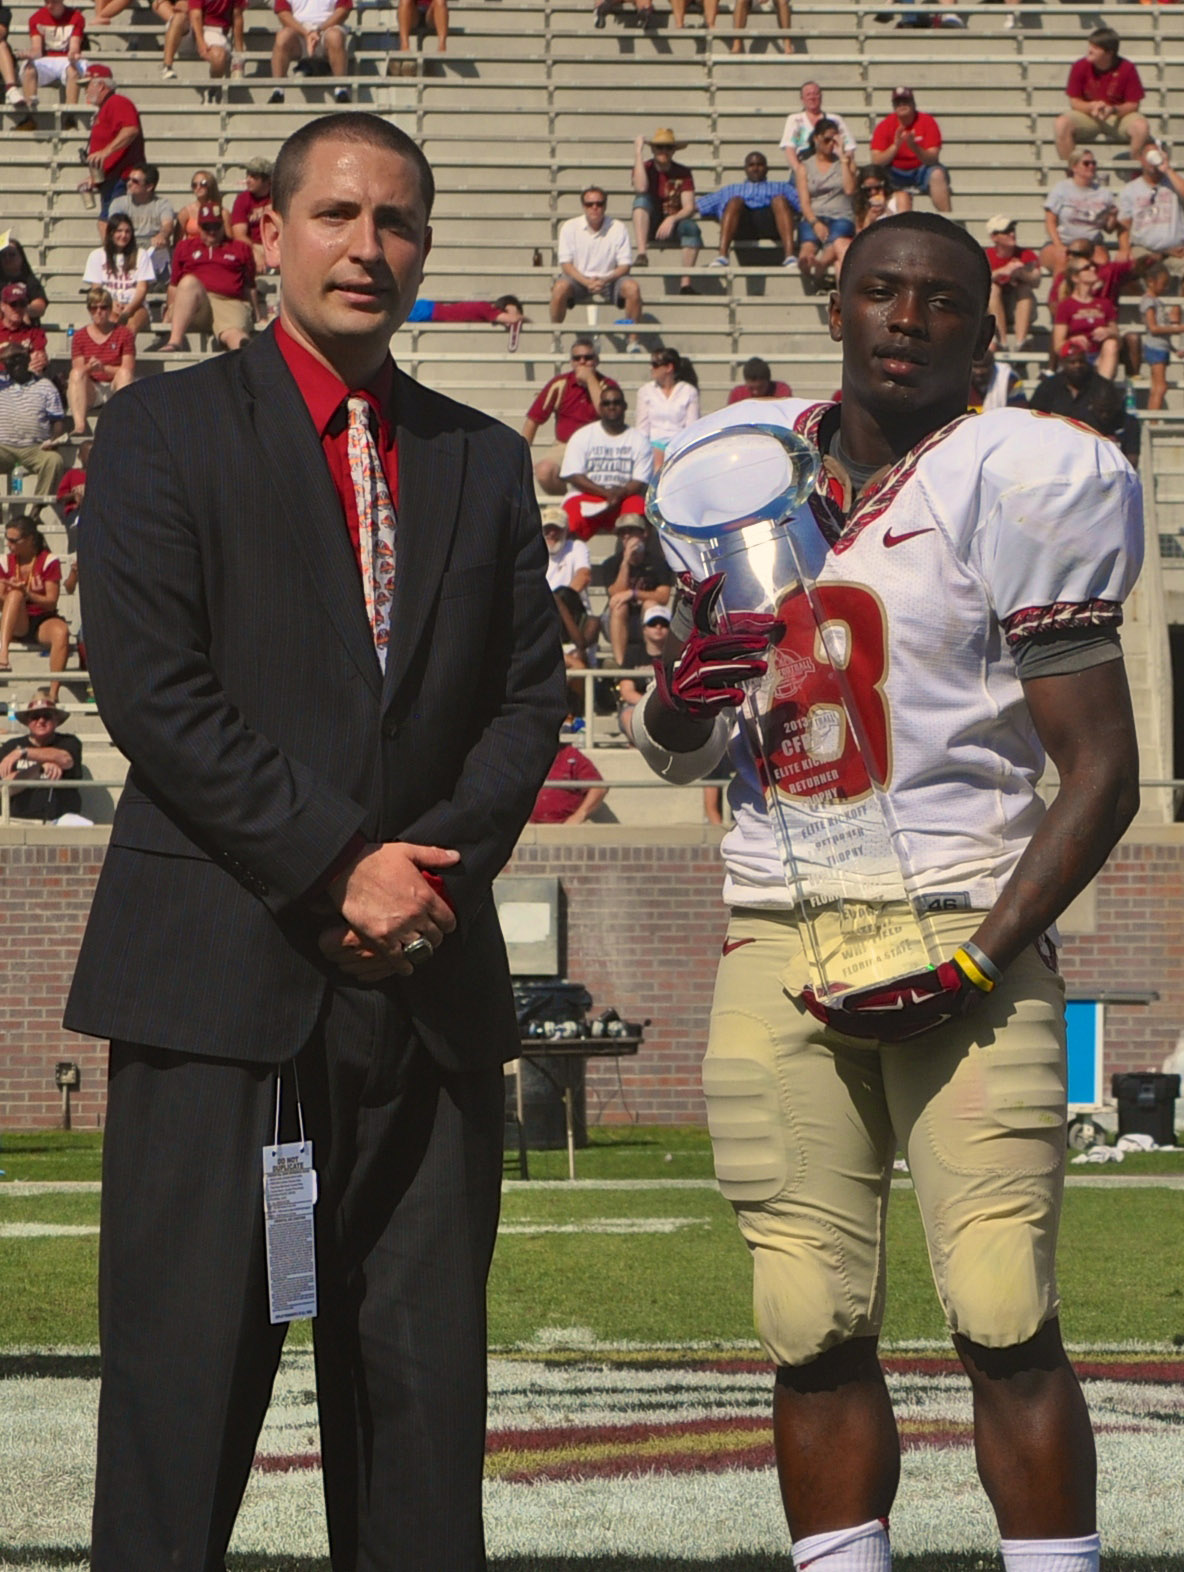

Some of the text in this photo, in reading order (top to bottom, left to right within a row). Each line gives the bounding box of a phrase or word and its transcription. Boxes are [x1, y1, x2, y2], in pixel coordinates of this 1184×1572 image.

[766, 580, 893, 805] 8
[783, 717, 809, 734] 2013
[774, 763, 800, 780] ELITE
[789, 769, 839, 794] RETURNER
[801, 818, 827, 840] ELITE
[928, 899, 958, 910] 46
